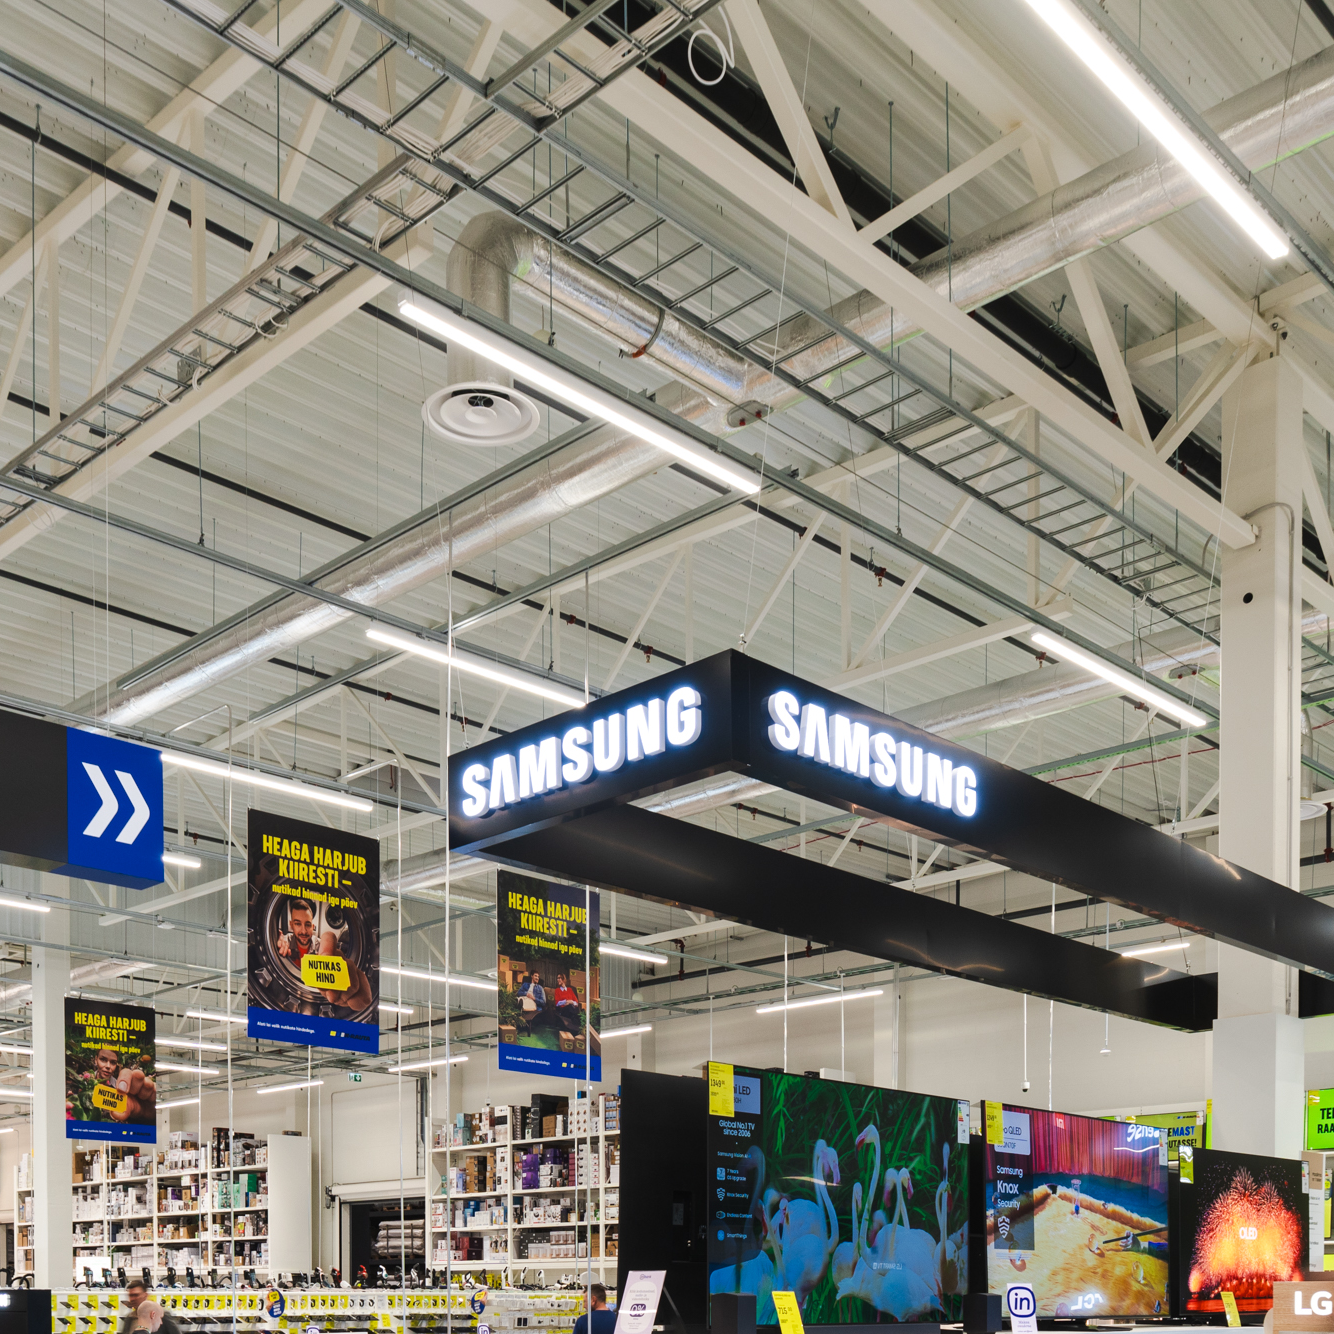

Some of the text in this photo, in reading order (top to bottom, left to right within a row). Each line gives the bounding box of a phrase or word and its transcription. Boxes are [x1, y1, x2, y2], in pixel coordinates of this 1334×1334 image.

[461, 685, 703, 818] SAMSUNG
[767, 690, 978, 818] SAMSUNG
[263, 834, 366, 875] HEAGA HARJUB
[279, 859, 338, 888] KIIRESTI
[272, 884, 358, 909] nutikad hinnad iga päev
[508, 892, 544, 915] HEAGA
[521, 912, 567, 937] KIIRESTI
[516, 934, 582, 956] nutikad hinnad iga päev
[309, 960, 341, 972] NUTIKAS
[316, 972, 335, 984] HIND
[75, 1012, 146, 1032] HEAGA HARJUB
[86, 1026, 127, 1042] KIIRESTI
[98, 1088, 123, 1102] NUTIKAS
[738, 1085, 751, 1095] LED
[102, 1098, 117, 1108] HIND
[719, 1120, 736, 1128] Global
[1009, 1126, 1022, 1136] QLED
[723, 1128, 751, 1137] since 2006
[997, 1165, 1023, 1178] Samsung
[997, 1181, 1019, 1195] Knox
[998, 1199, 1020, 1210] Security
[1239, 1228, 1257, 1240] OLED
[1015, 1293, 1030, 1310] in
[1294, 1291, 1333, 1316] LG
